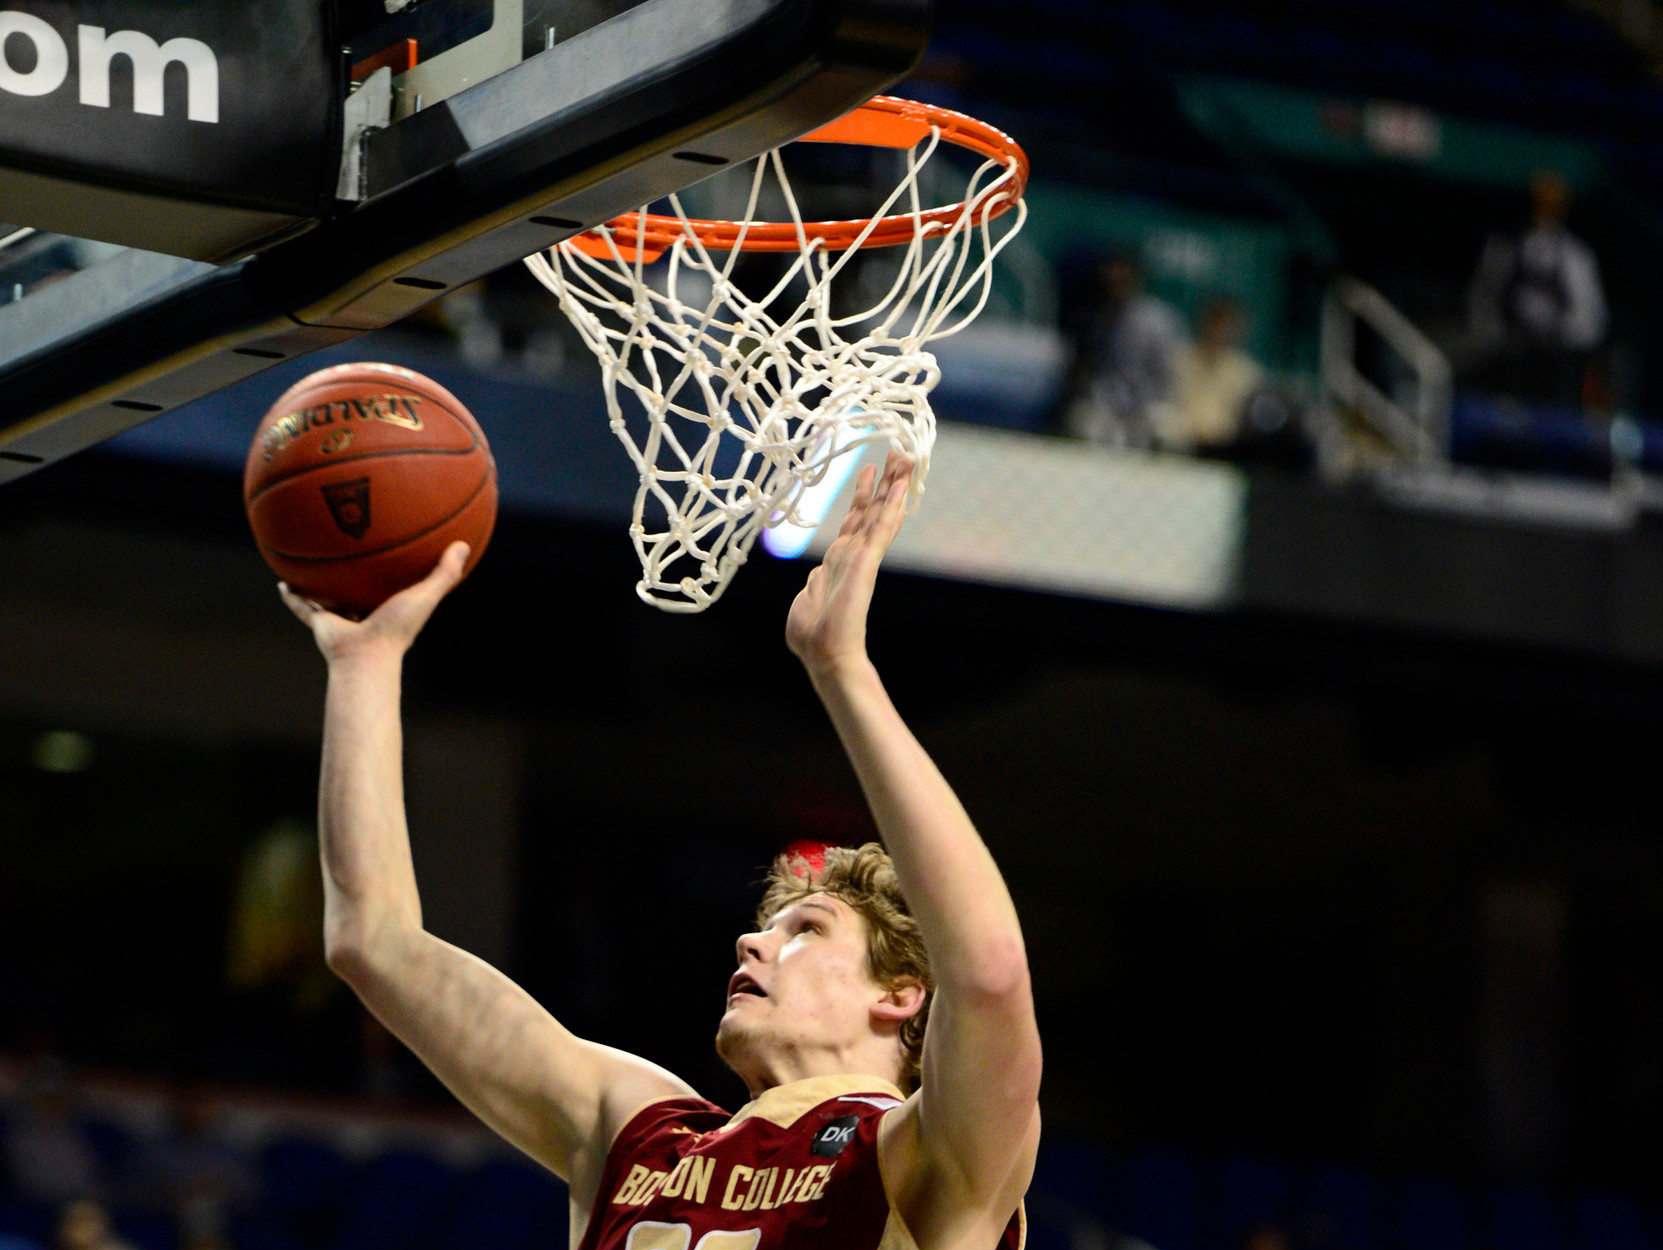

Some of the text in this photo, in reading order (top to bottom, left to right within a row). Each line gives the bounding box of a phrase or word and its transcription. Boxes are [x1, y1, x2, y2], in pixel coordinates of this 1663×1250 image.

[0, 10, 219, 124] om
[820, 1126, 855, 1142] DK
[612, 1155, 717, 1206] BOON
